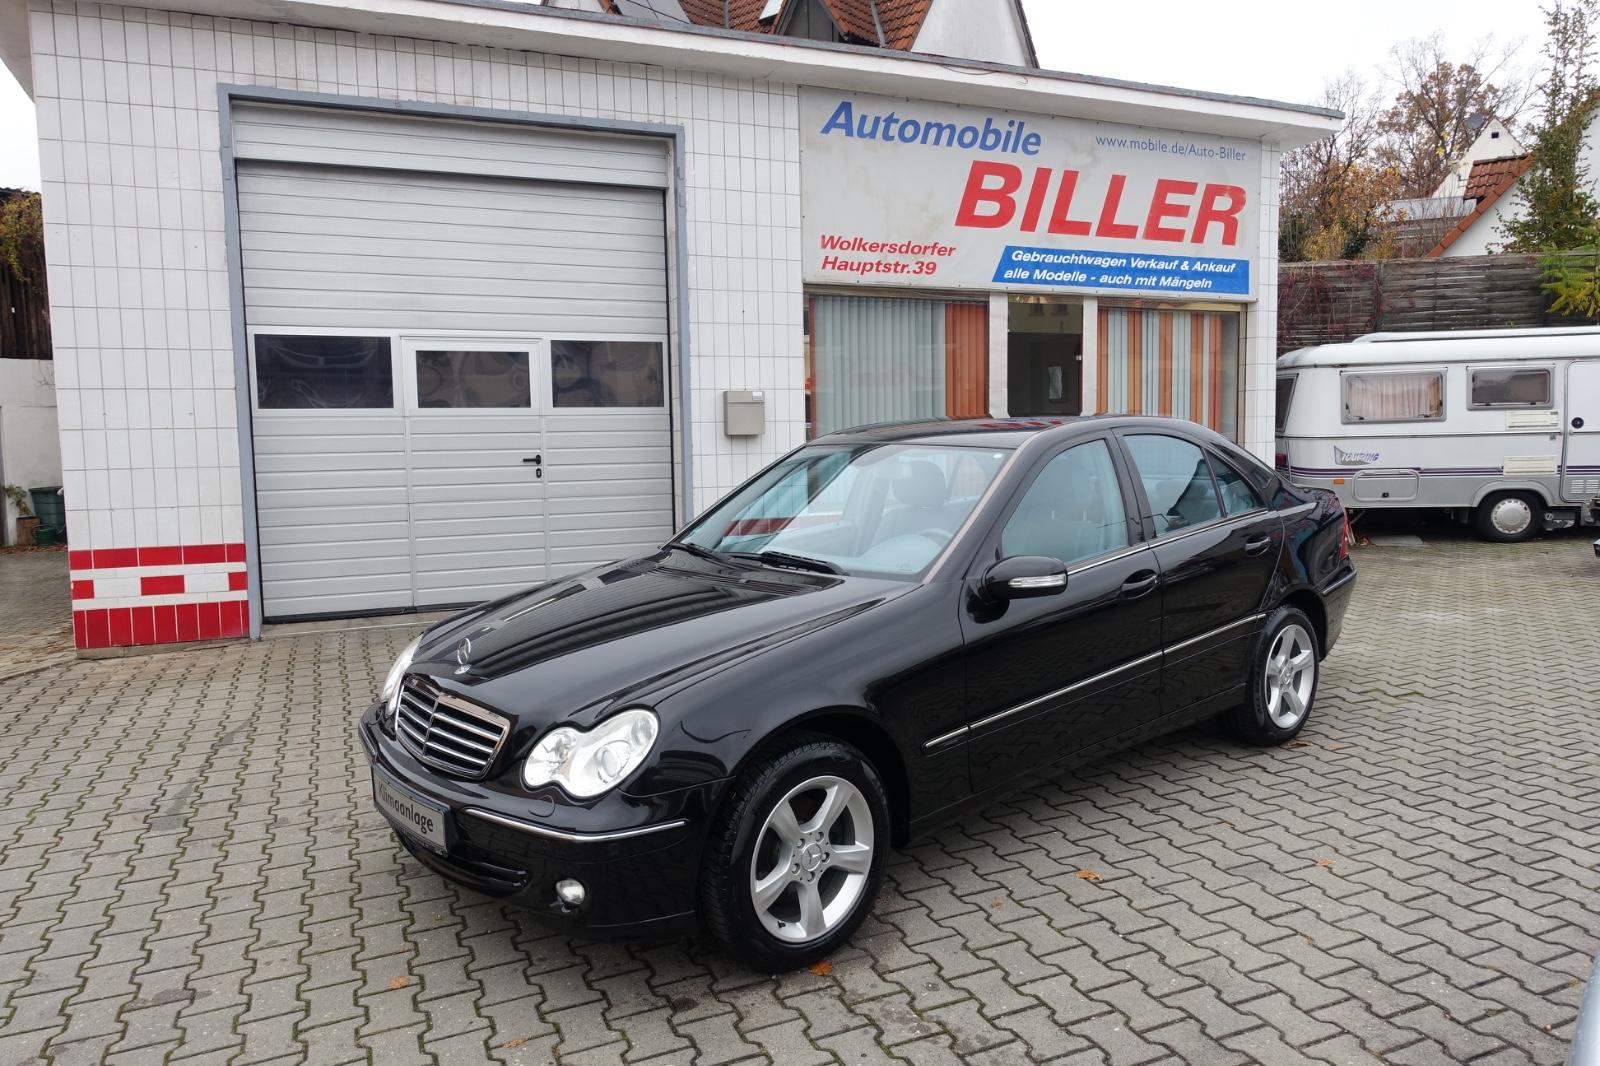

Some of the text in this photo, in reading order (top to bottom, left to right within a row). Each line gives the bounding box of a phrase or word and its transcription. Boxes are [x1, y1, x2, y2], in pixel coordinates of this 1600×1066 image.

[820, 100, 1042, 156] Automobile
[1095, 135, 1247, 161] www.mobile.de/Auto-Biller
[954, 160, 1247, 247] BILLER
[820, 234, 957, 257] Wolkersdorfer
[821, 255, 938, 276] Hauptstr.39
[1011, 250, 1237, 273] Gebrauchtwagen Verkauf & Ankauf
[1003, 267, 1030, 279] alle
[1032, 268, 1087, 282] Modelle
[1099, 273, 1132, 285] auch
[1134, 275, 1157, 287] mit
[1159, 276, 1213, 290] Mängeln
[378, 781, 434, 835] Klimaanlage
